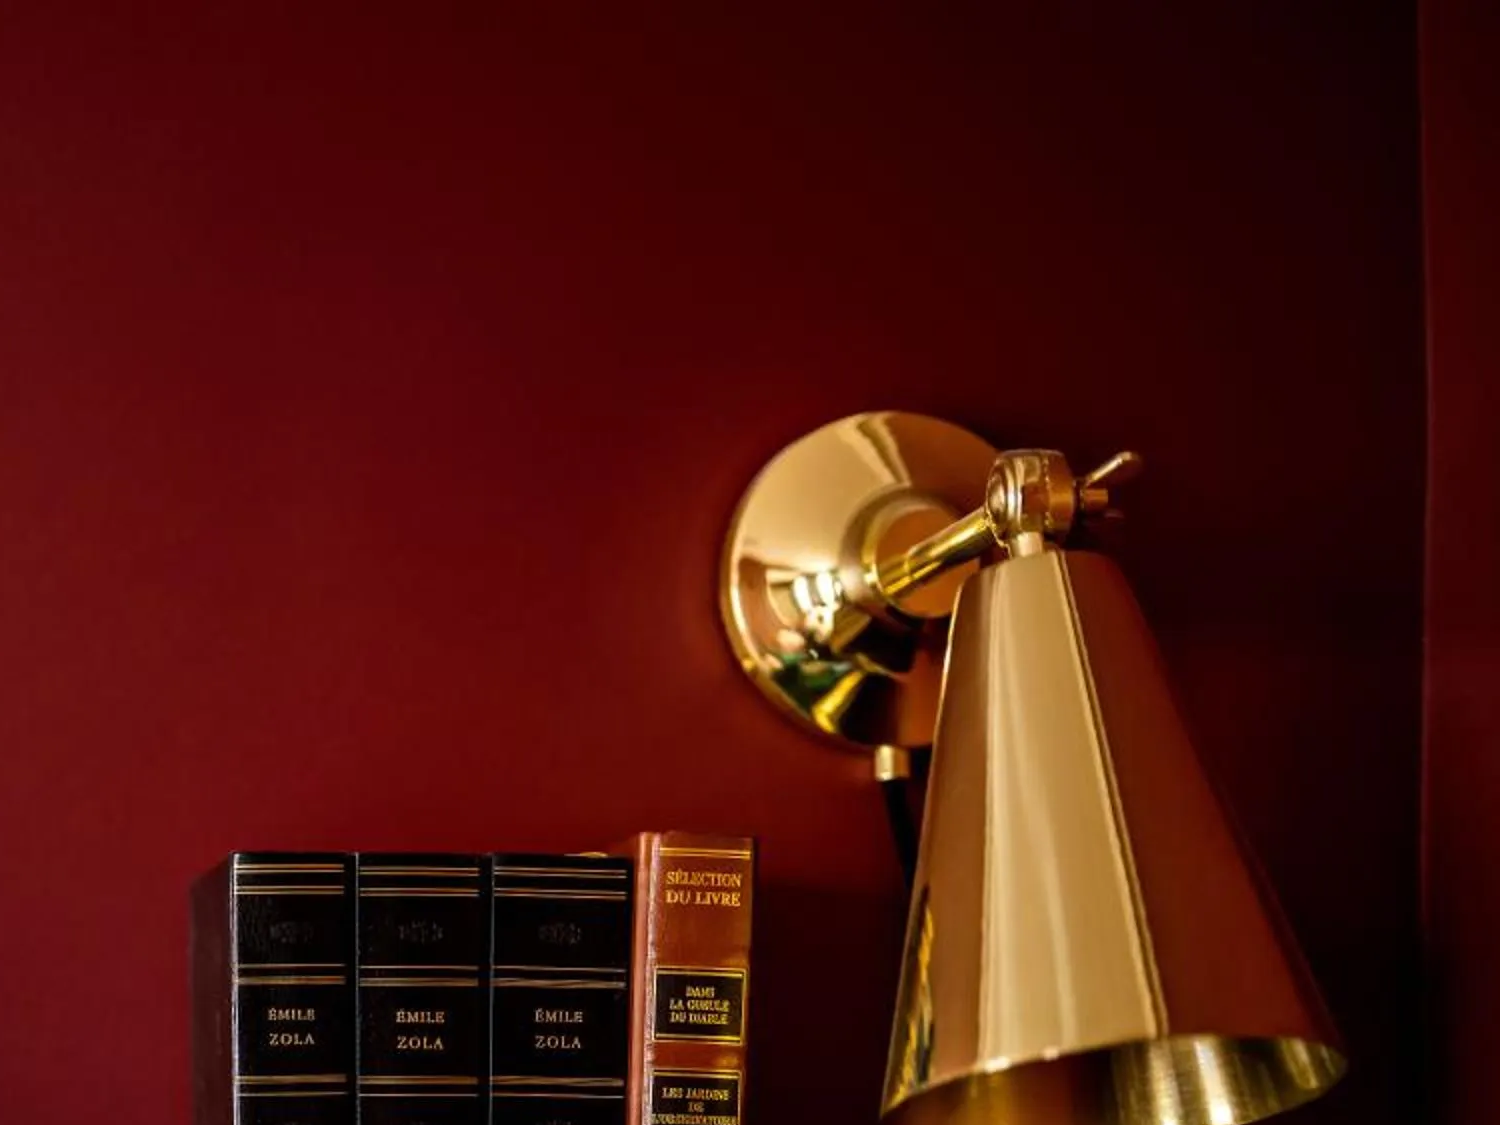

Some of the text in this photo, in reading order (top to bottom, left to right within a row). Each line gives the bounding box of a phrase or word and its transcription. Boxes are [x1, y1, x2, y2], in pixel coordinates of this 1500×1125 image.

[666, 869, 742, 887] SÉLECTION
[665, 890, 741, 907] DU LIVRE
[669, 999, 684, 1010] LA
[268, 1007, 315, 1021] ÉMILE
[396, 1009, 445, 1023] ÉMILE
[535, 1008, 583, 1022] ÉMILE
[670, 1012, 687, 1023] DU
[269, 1033, 315, 1045] ZOLA
[397, 1036, 443, 1049] ZOLA
[535, 1036, 581, 1048] ZOLA
